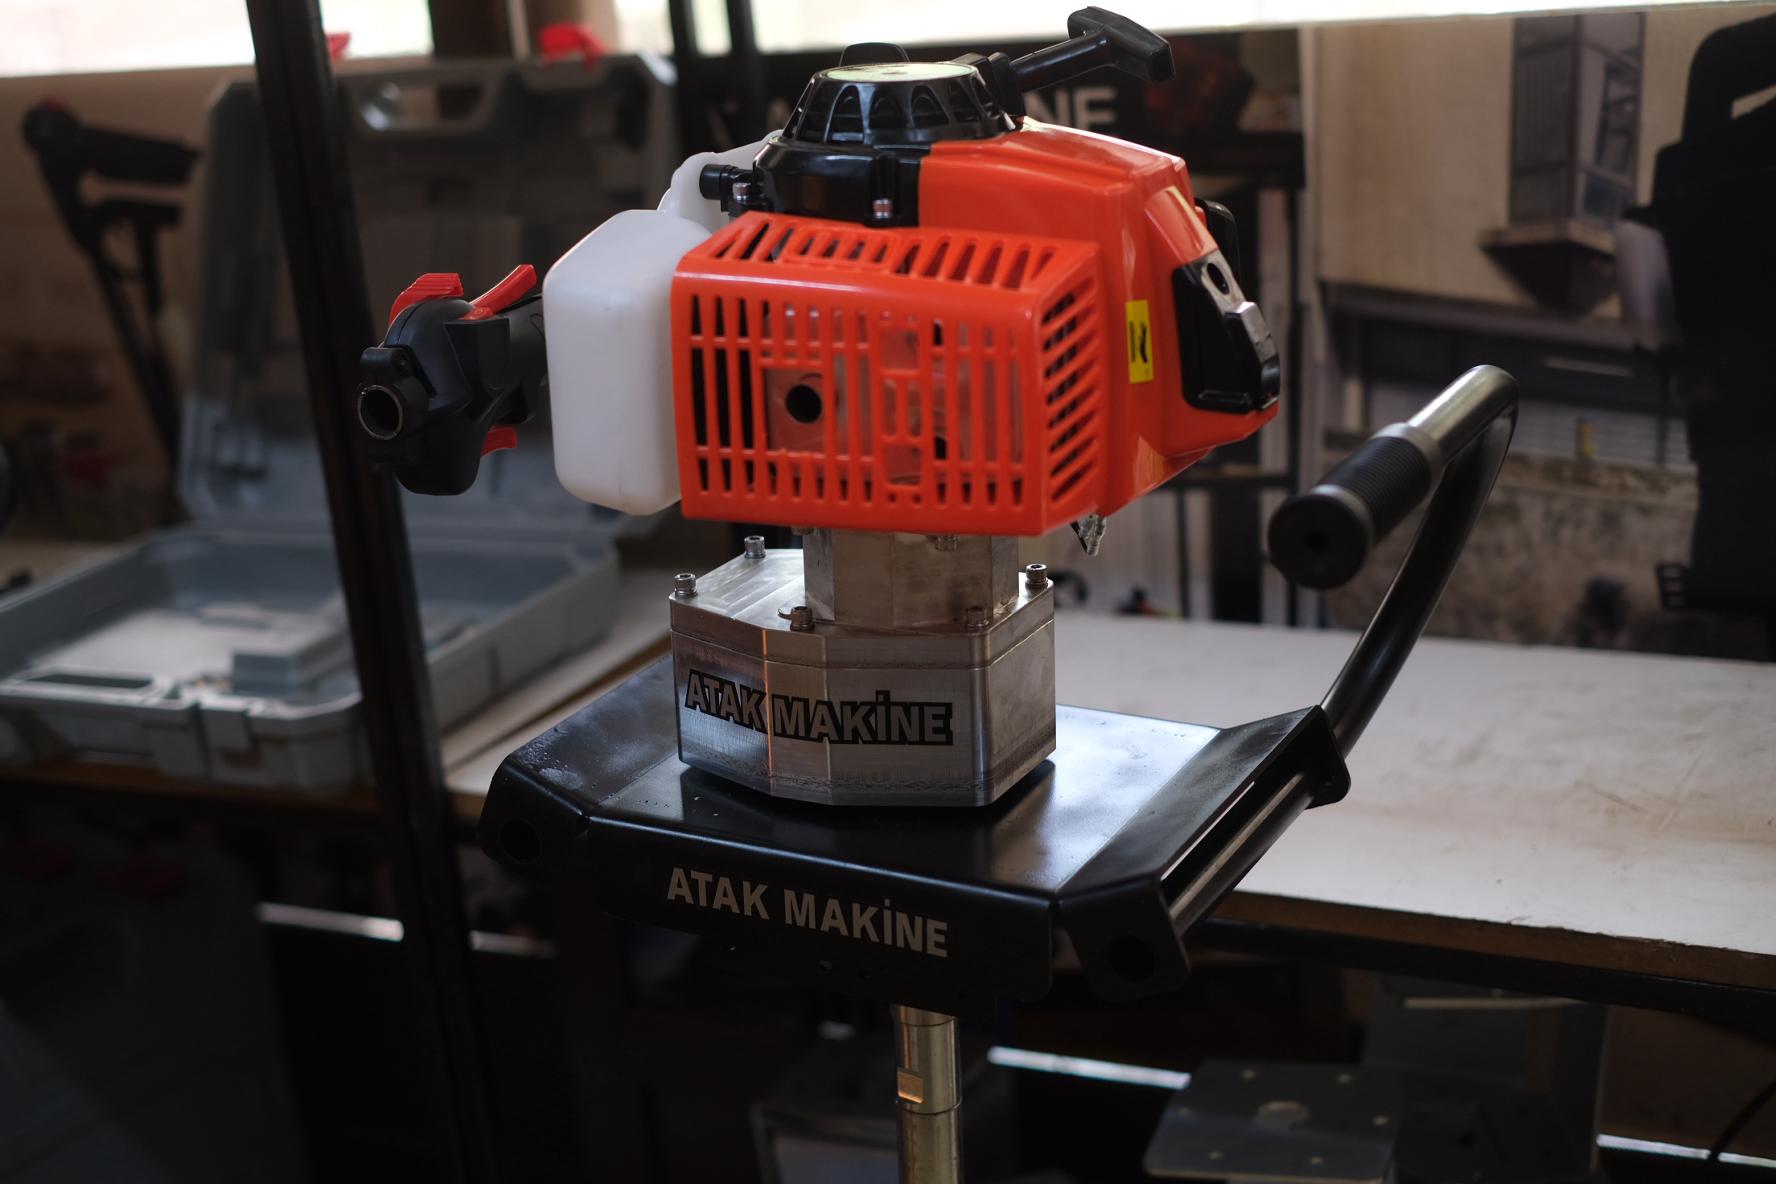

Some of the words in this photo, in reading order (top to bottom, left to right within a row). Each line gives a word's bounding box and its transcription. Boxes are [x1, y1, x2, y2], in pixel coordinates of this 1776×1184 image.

[685, 668, 769, 734] ATAK
[771, 690, 954, 746] MAKİNE
[667, 865, 770, 921] ATAK
[783, 886, 949, 958] MAKİNE
